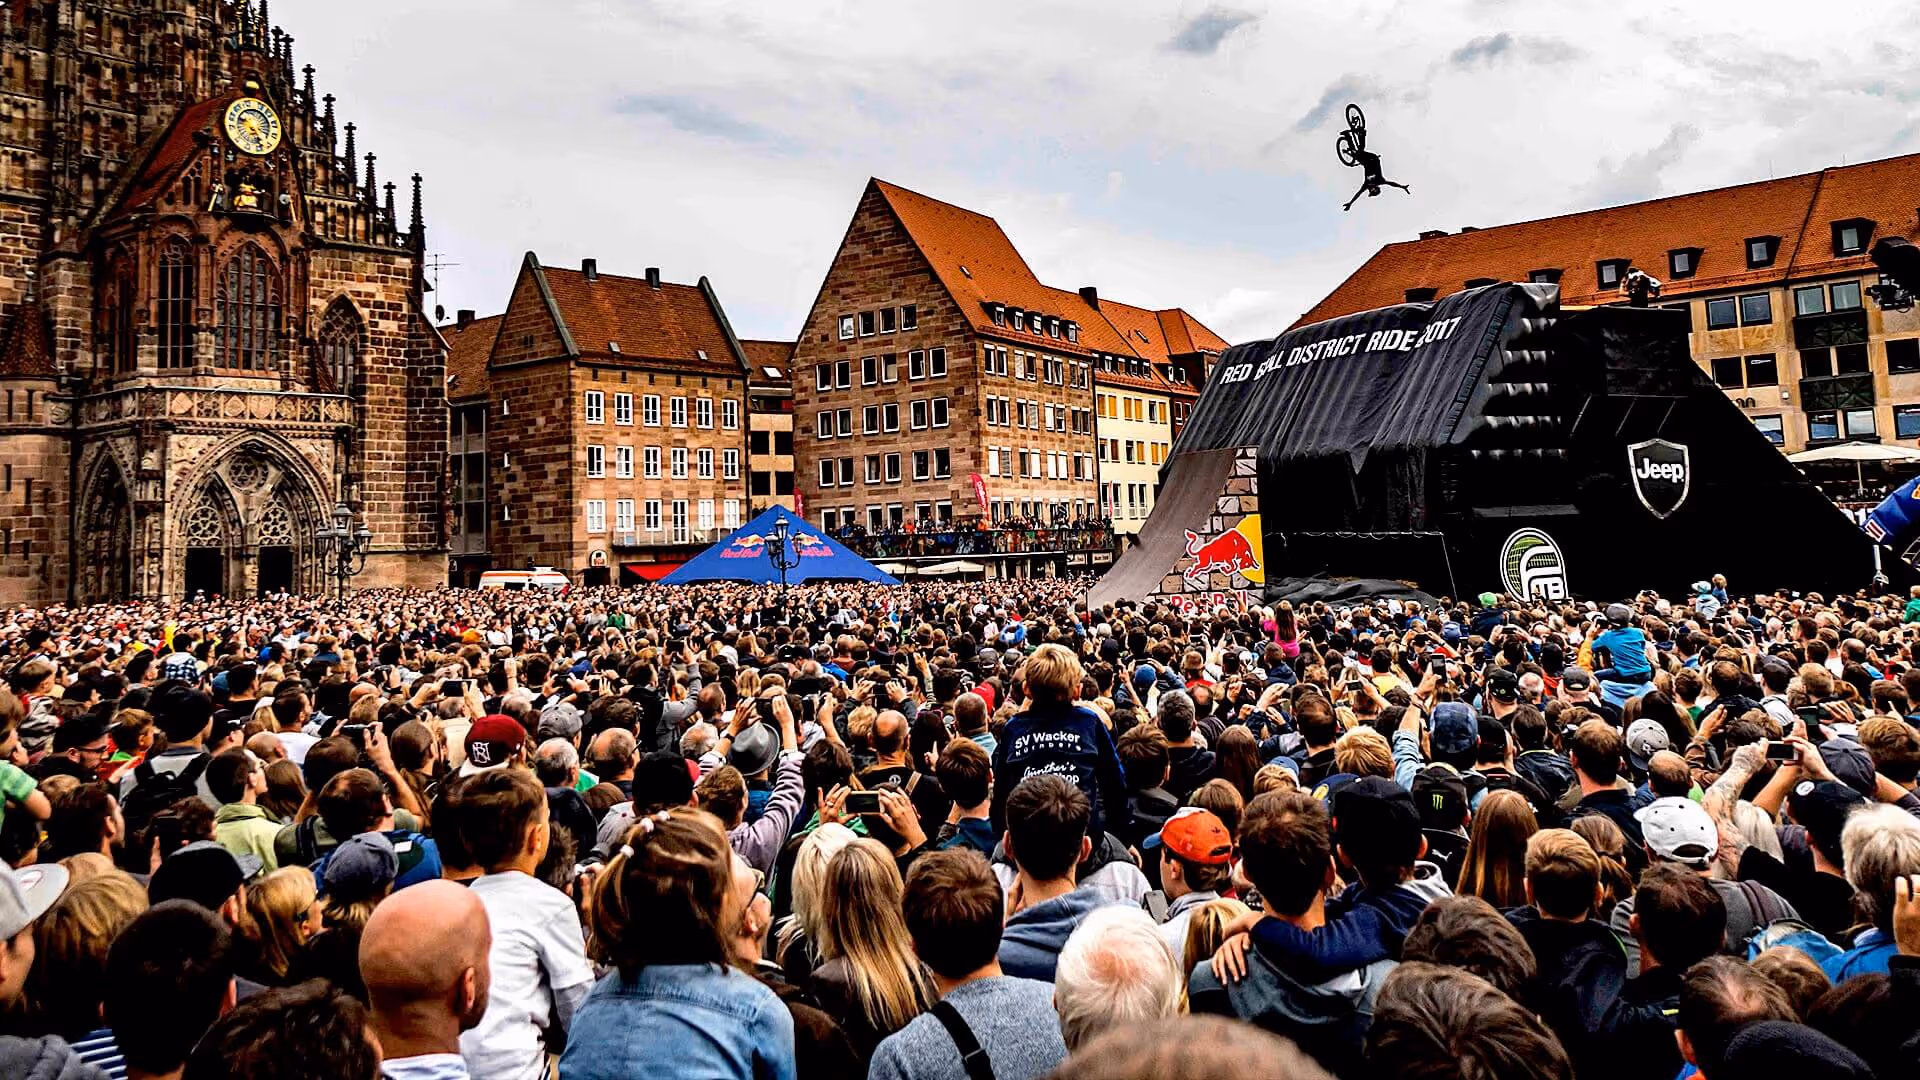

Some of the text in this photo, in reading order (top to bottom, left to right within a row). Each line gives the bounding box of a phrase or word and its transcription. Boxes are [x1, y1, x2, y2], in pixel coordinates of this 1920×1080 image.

[1219, 364, 1253, 385] RED
[1286, 333, 1367, 367] DISTRICT
[1365, 329, 1418, 353] RIDE
[1415, 316, 1462, 348] 2017
[1637, 457, 1684, 484] Jeep
[720, 546, 764, 559] Red Bull
[1014, 730, 1081, 750] SV Wacker
